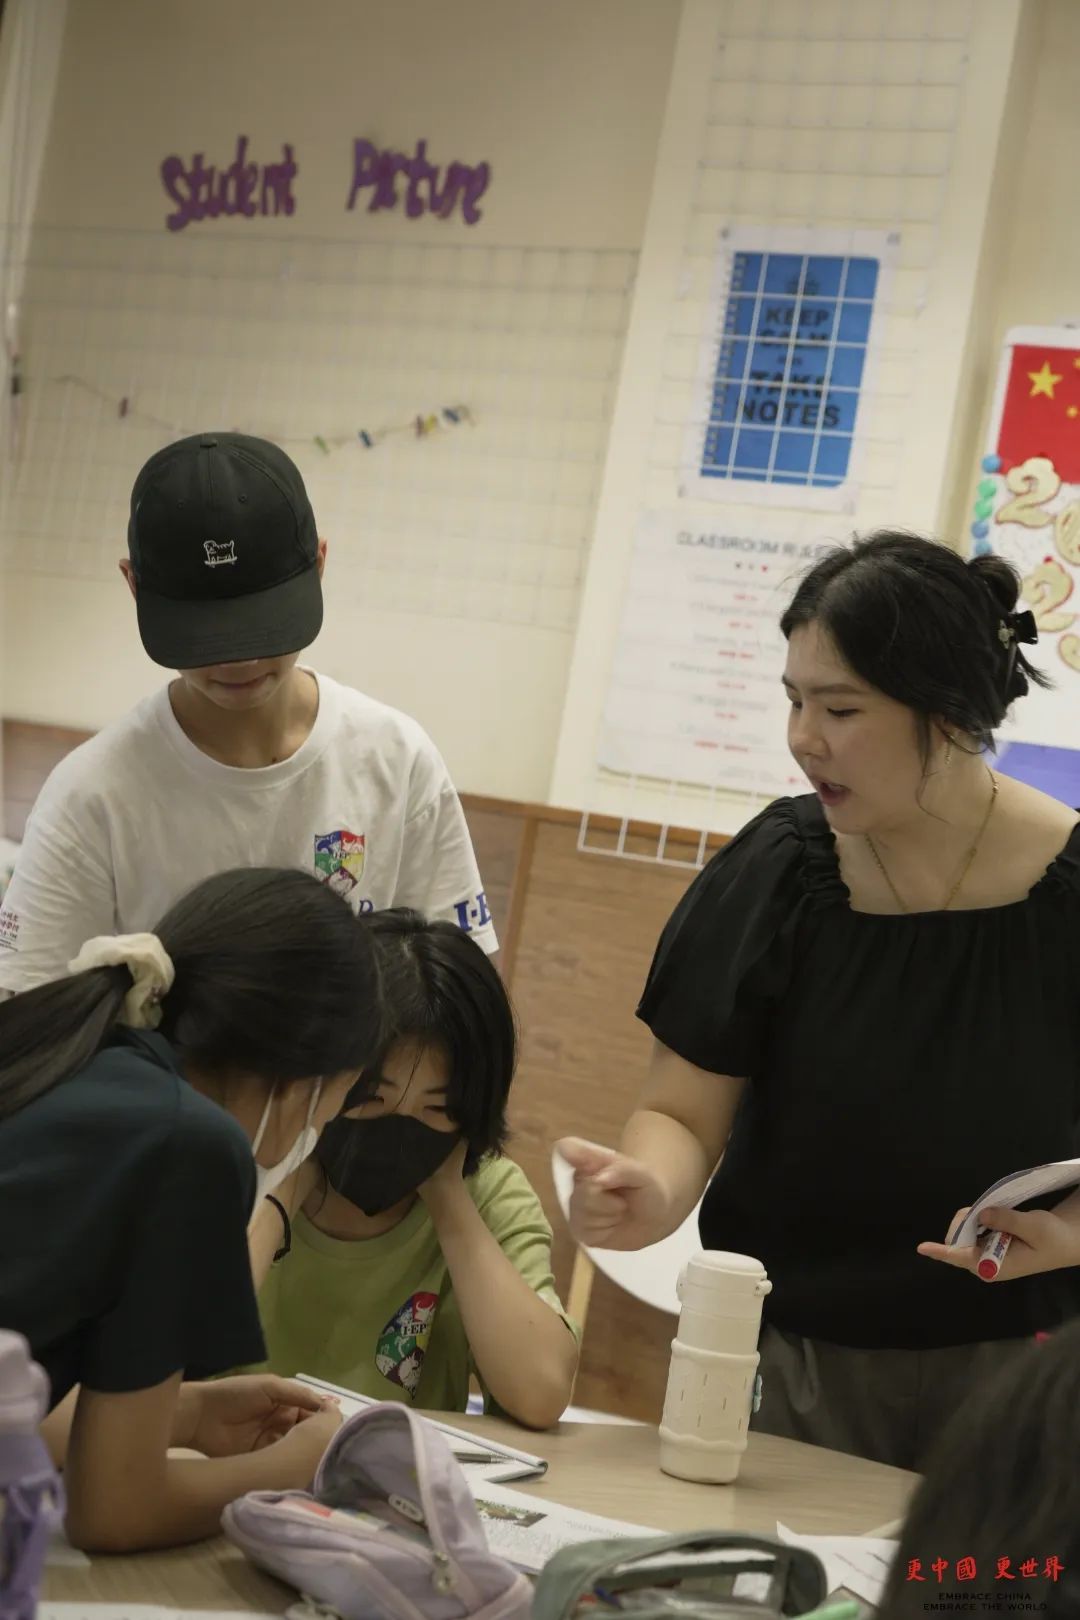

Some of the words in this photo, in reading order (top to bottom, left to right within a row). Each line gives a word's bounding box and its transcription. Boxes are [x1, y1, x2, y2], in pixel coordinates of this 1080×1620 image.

[161, 133, 298, 231] Student
[764, 307, 829, 327] KEEP
[751, 371, 831, 399] TAKE
[738, 399, 840, 427] NOTES
